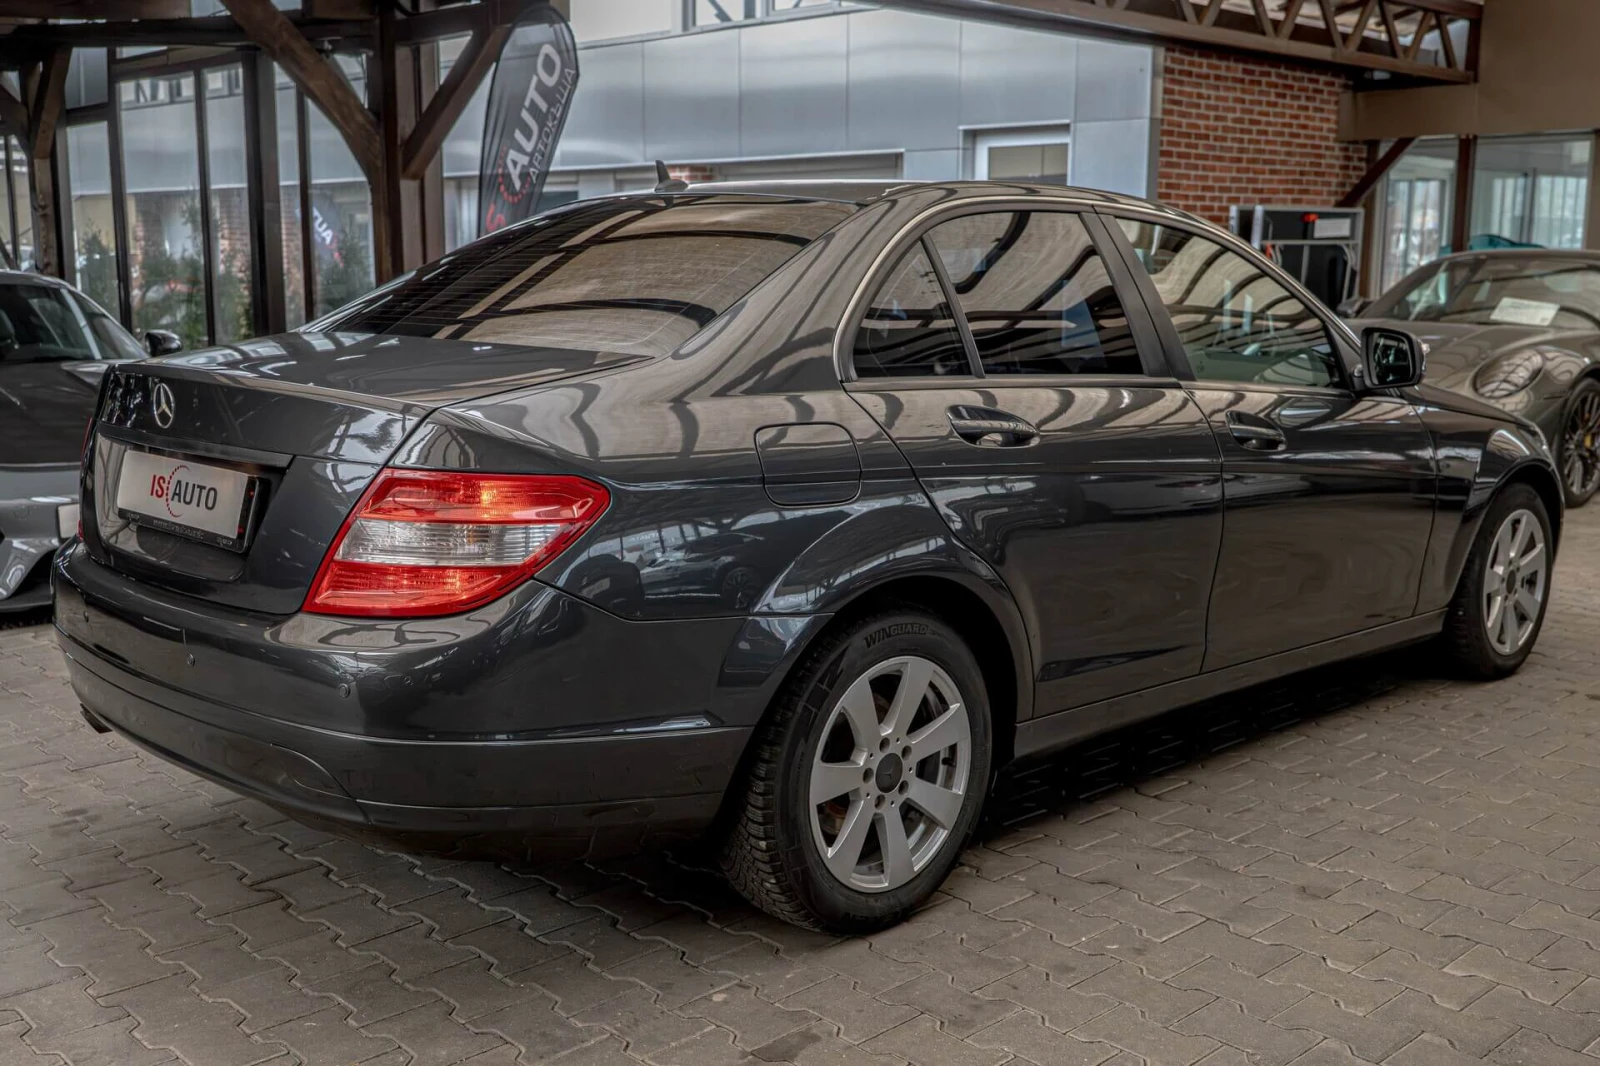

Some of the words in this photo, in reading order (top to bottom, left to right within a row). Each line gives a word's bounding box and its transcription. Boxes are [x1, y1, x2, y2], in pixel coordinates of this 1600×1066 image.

[506, 44, 562, 192] AUTO
[150, 474, 166, 499] IS
[171, 479, 218, 511] AUTO
[863, 623, 929, 649] WINGUARD
